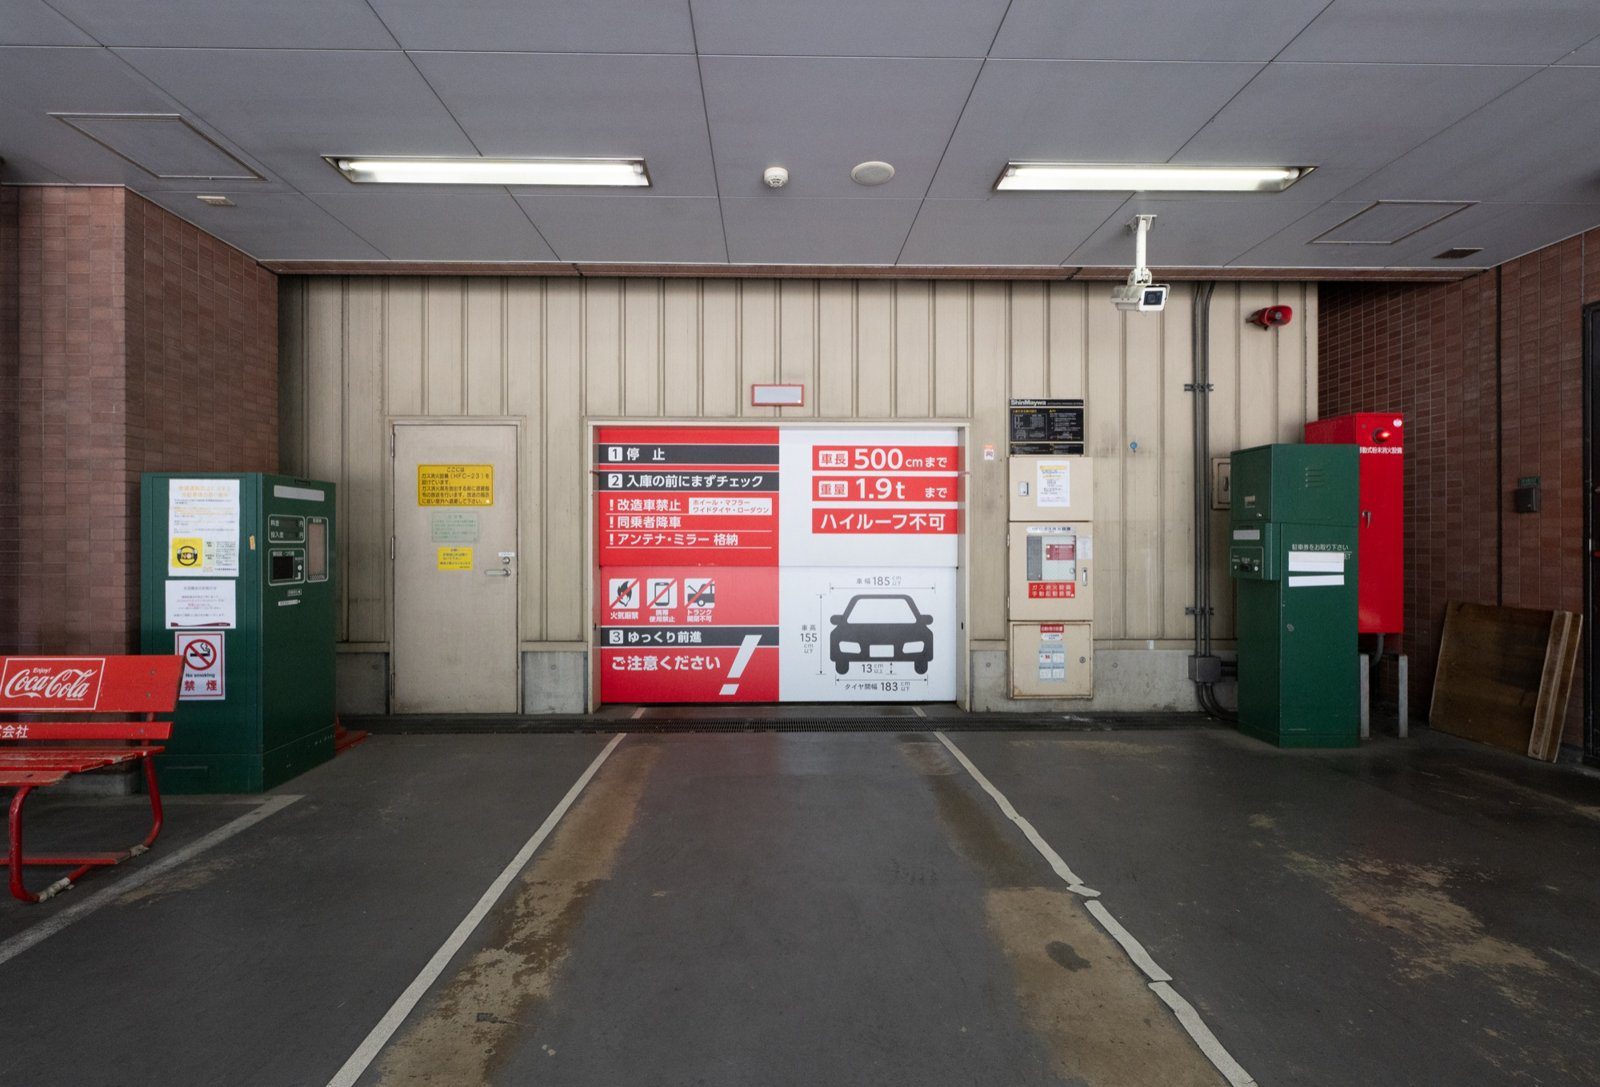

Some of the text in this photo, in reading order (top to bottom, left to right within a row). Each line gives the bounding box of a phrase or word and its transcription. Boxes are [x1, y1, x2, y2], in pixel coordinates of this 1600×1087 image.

[627, 474, 763, 488] 入庫の前にまずチェック
[820, 484, 846, 496] 重量
[924, 487, 948, 498] まで
[820, 513, 946, 531] ハイルーフ不可
[873, 576, 890, 586] 185
[628, 631, 702, 643] ゆっくり前進
[800, 633, 818, 642] 155
[612, 656, 721, 671] ご注意ください
[862, 664, 873, 673] 13
[880, 682, 898, 692] 183
[0, 724, 29, 738] 会社
